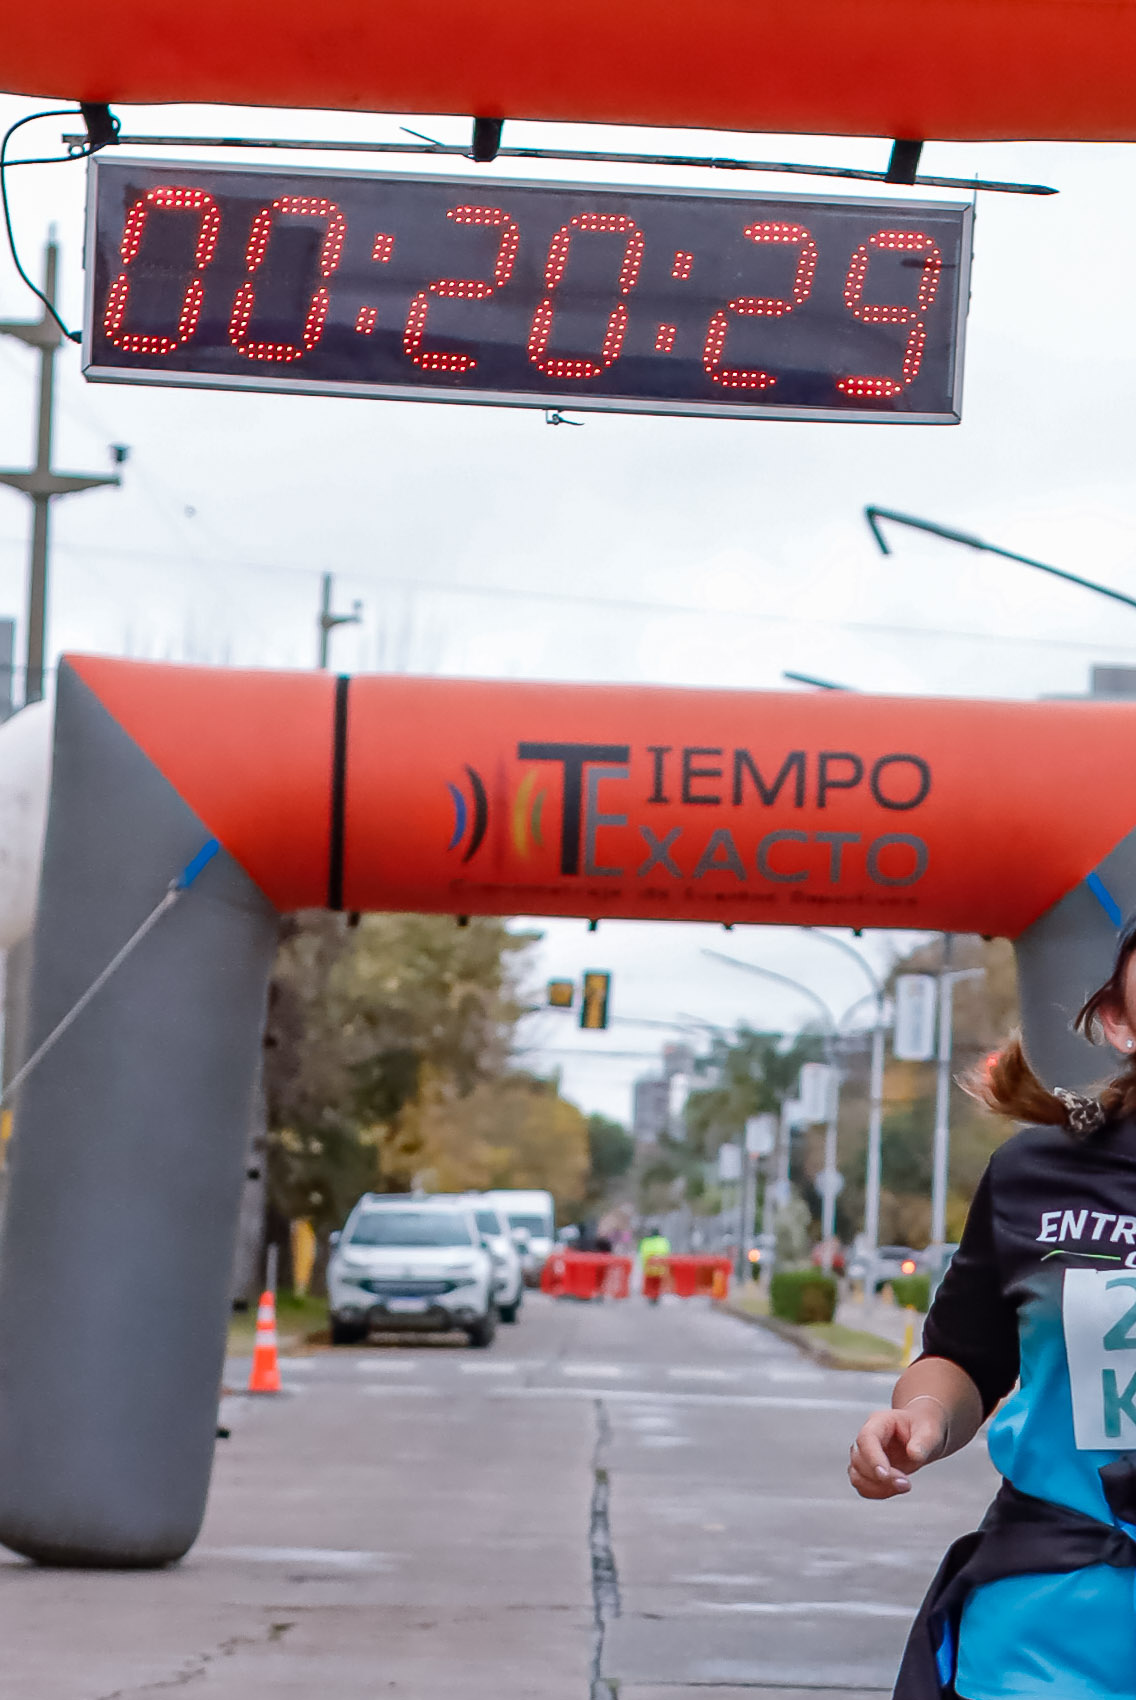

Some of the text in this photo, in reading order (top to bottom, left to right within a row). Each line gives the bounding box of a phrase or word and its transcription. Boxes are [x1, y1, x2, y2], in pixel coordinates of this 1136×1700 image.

[104, 185, 942, 397] 00:20:29
[517, 741, 932, 877] TIEMPO
[584, 766, 931, 887] EXACTO
